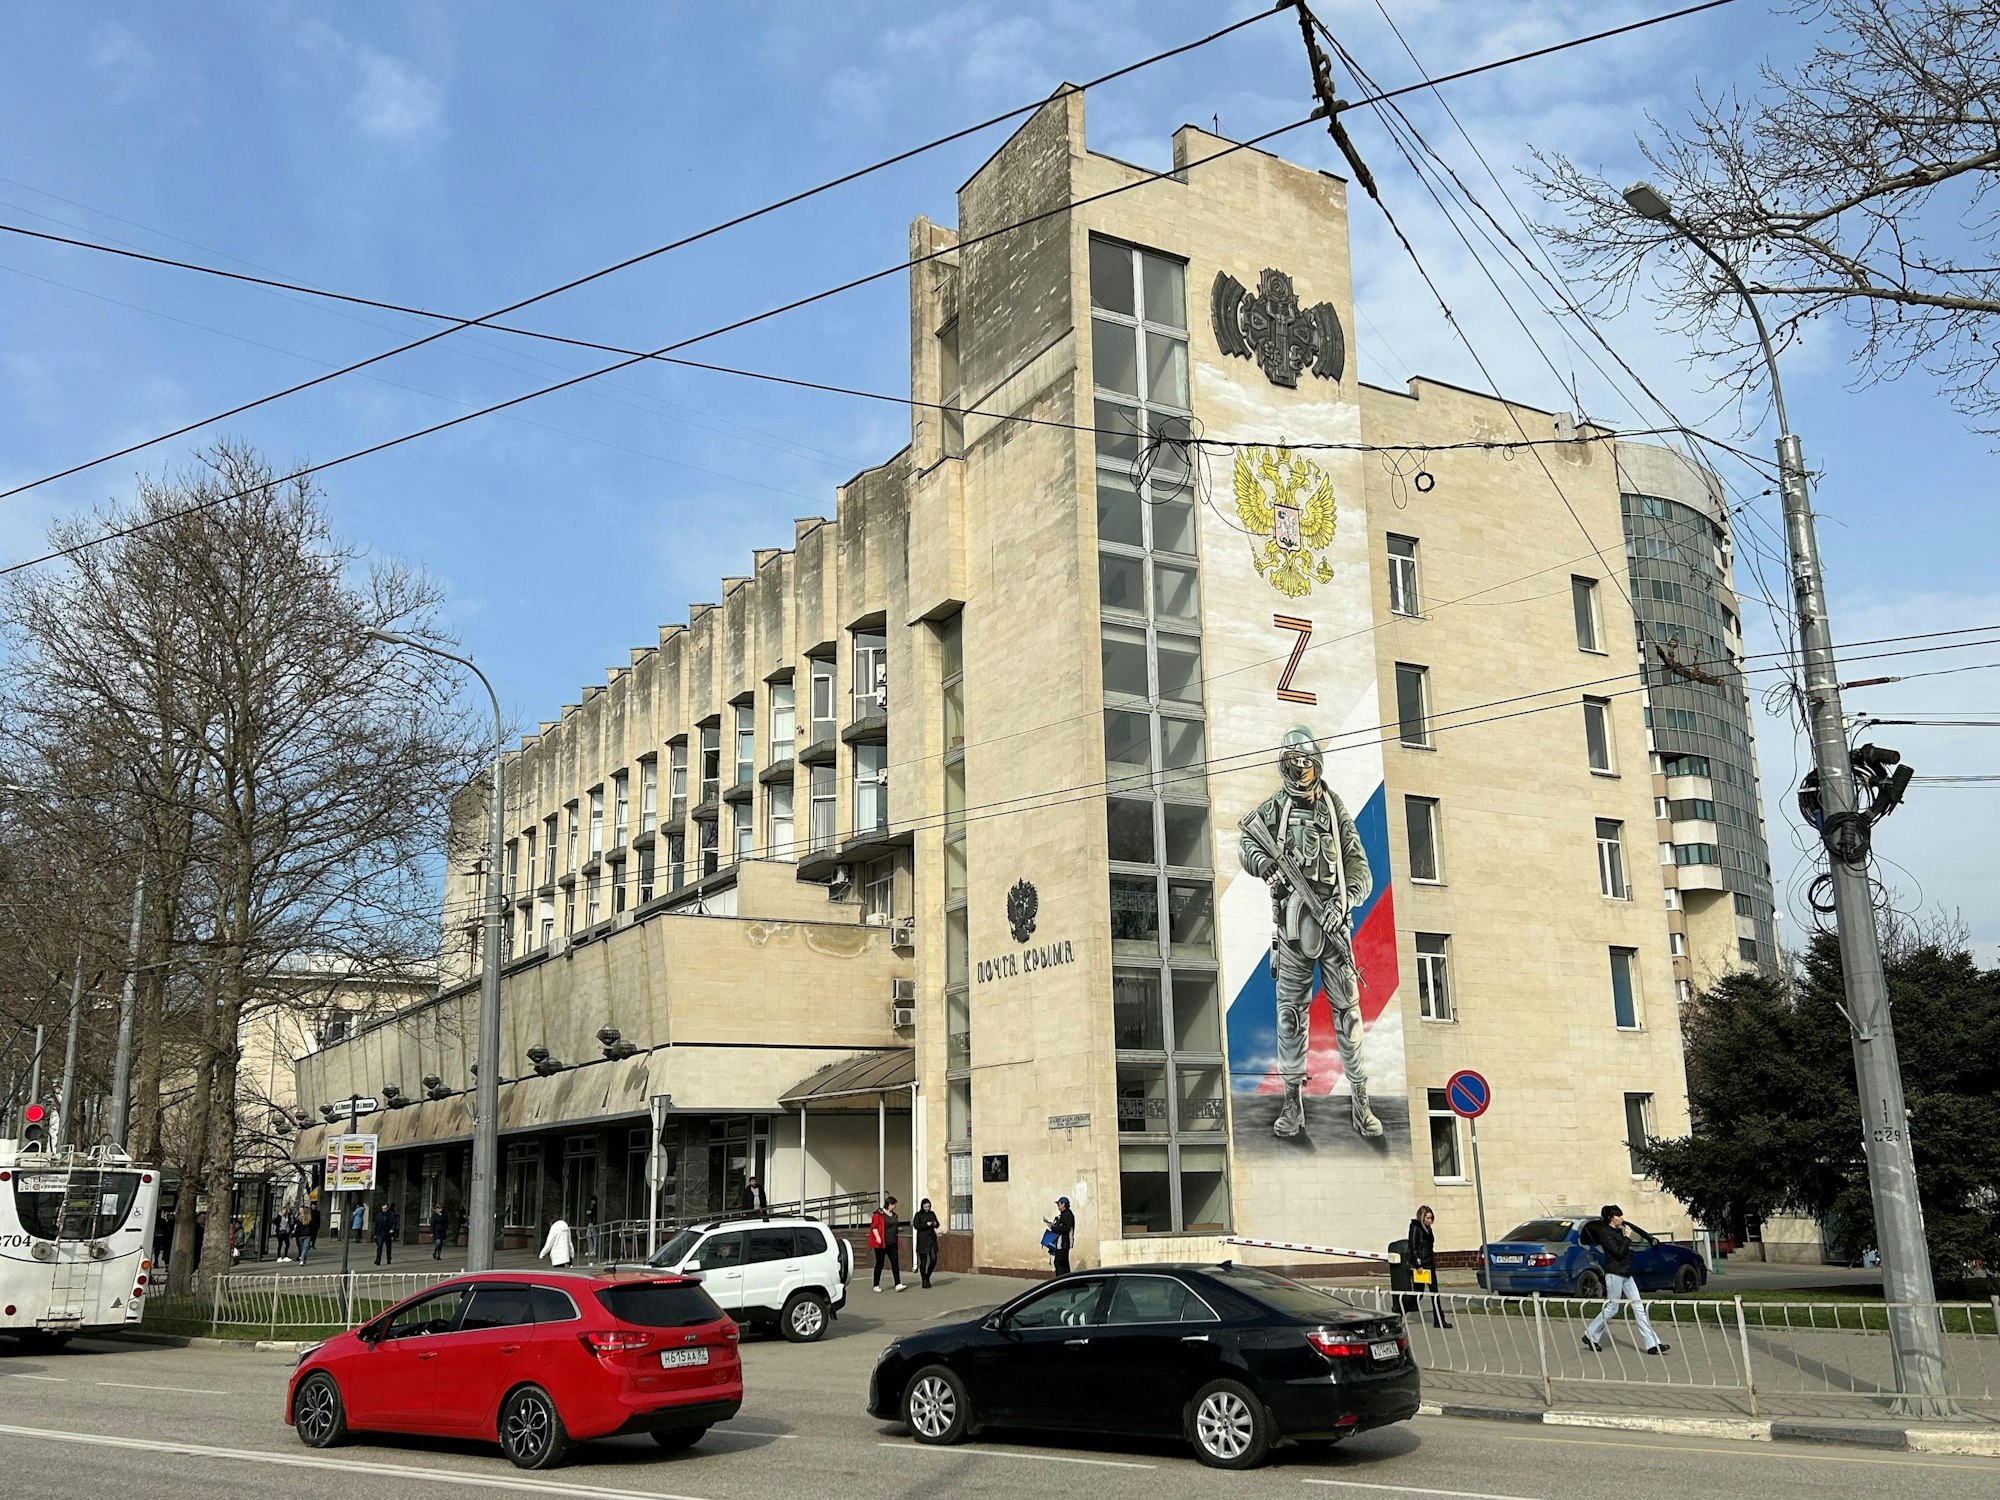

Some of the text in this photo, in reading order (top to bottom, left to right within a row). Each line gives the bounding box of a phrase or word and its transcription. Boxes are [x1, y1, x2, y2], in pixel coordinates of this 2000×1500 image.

[1273, 613, 1317, 706] Z
[977, 939, 1075, 983] ПОЧТА КРЫМА
[1882, 1099, 1887, 1111] 1
[1883, 1111, 1888, 1123] 1
[0, 1234, 32, 1248] 704
